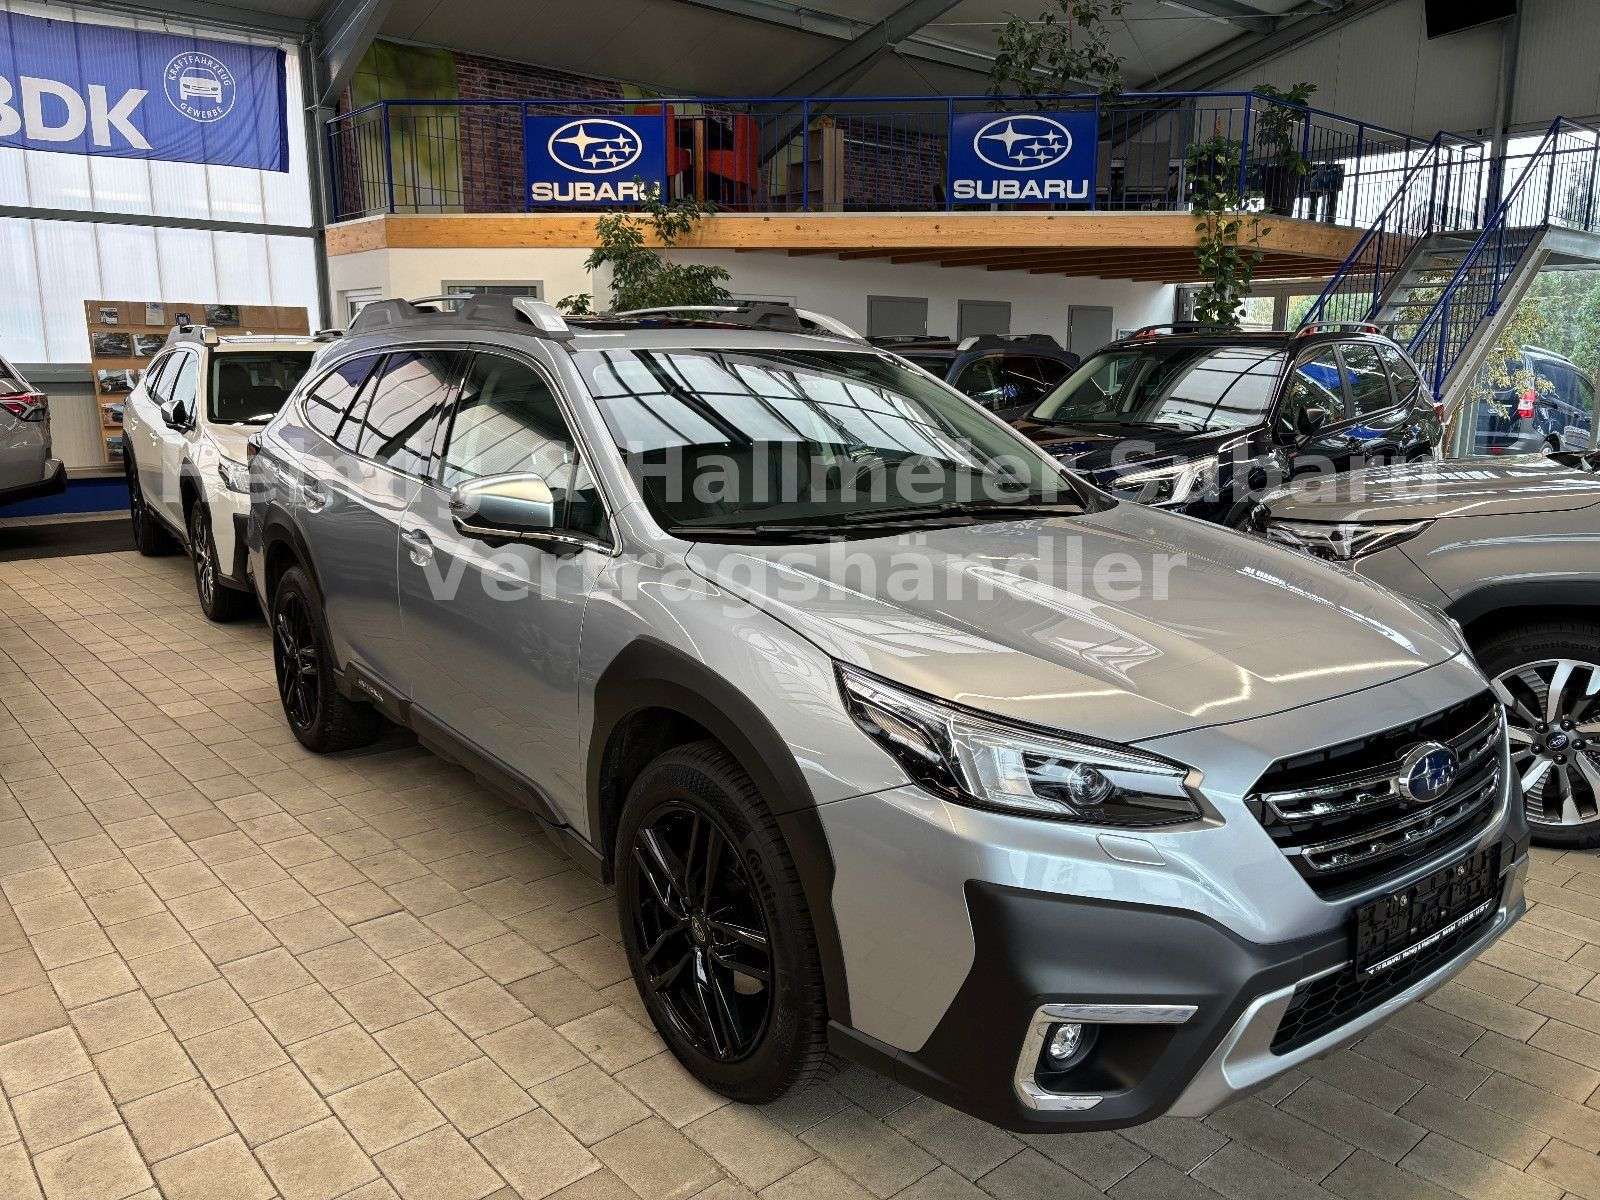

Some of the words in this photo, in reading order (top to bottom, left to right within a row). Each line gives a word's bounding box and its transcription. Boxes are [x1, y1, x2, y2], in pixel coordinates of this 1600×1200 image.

[168, 55, 231, 86] KRAFTFAHRZEUG
[180, 103, 223, 118] GEWERBE
[953, 179, 1088, 200] SUBARU
